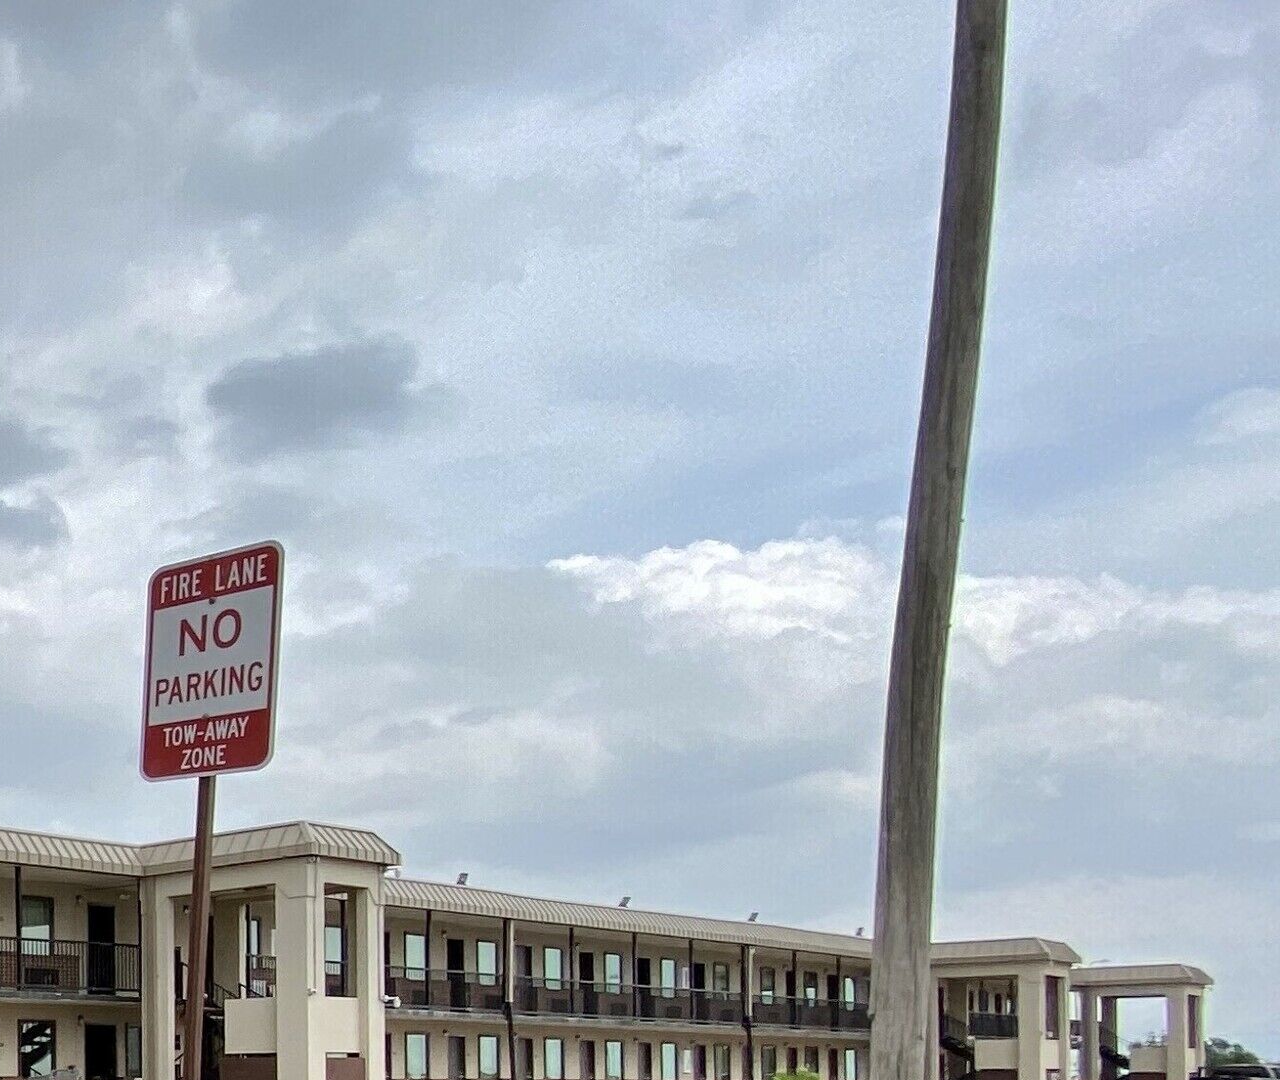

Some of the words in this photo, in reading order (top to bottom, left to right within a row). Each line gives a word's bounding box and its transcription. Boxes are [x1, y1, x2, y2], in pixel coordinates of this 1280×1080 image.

[160, 568, 203, 604] FIRE
[214, 553, 269, 592] LANE
[178, 608, 241, 657] NO
[154, 661, 264, 707] PARKING
[163, 715, 250, 747] TOW-AWAY
[180, 745, 227, 770] ZONE
